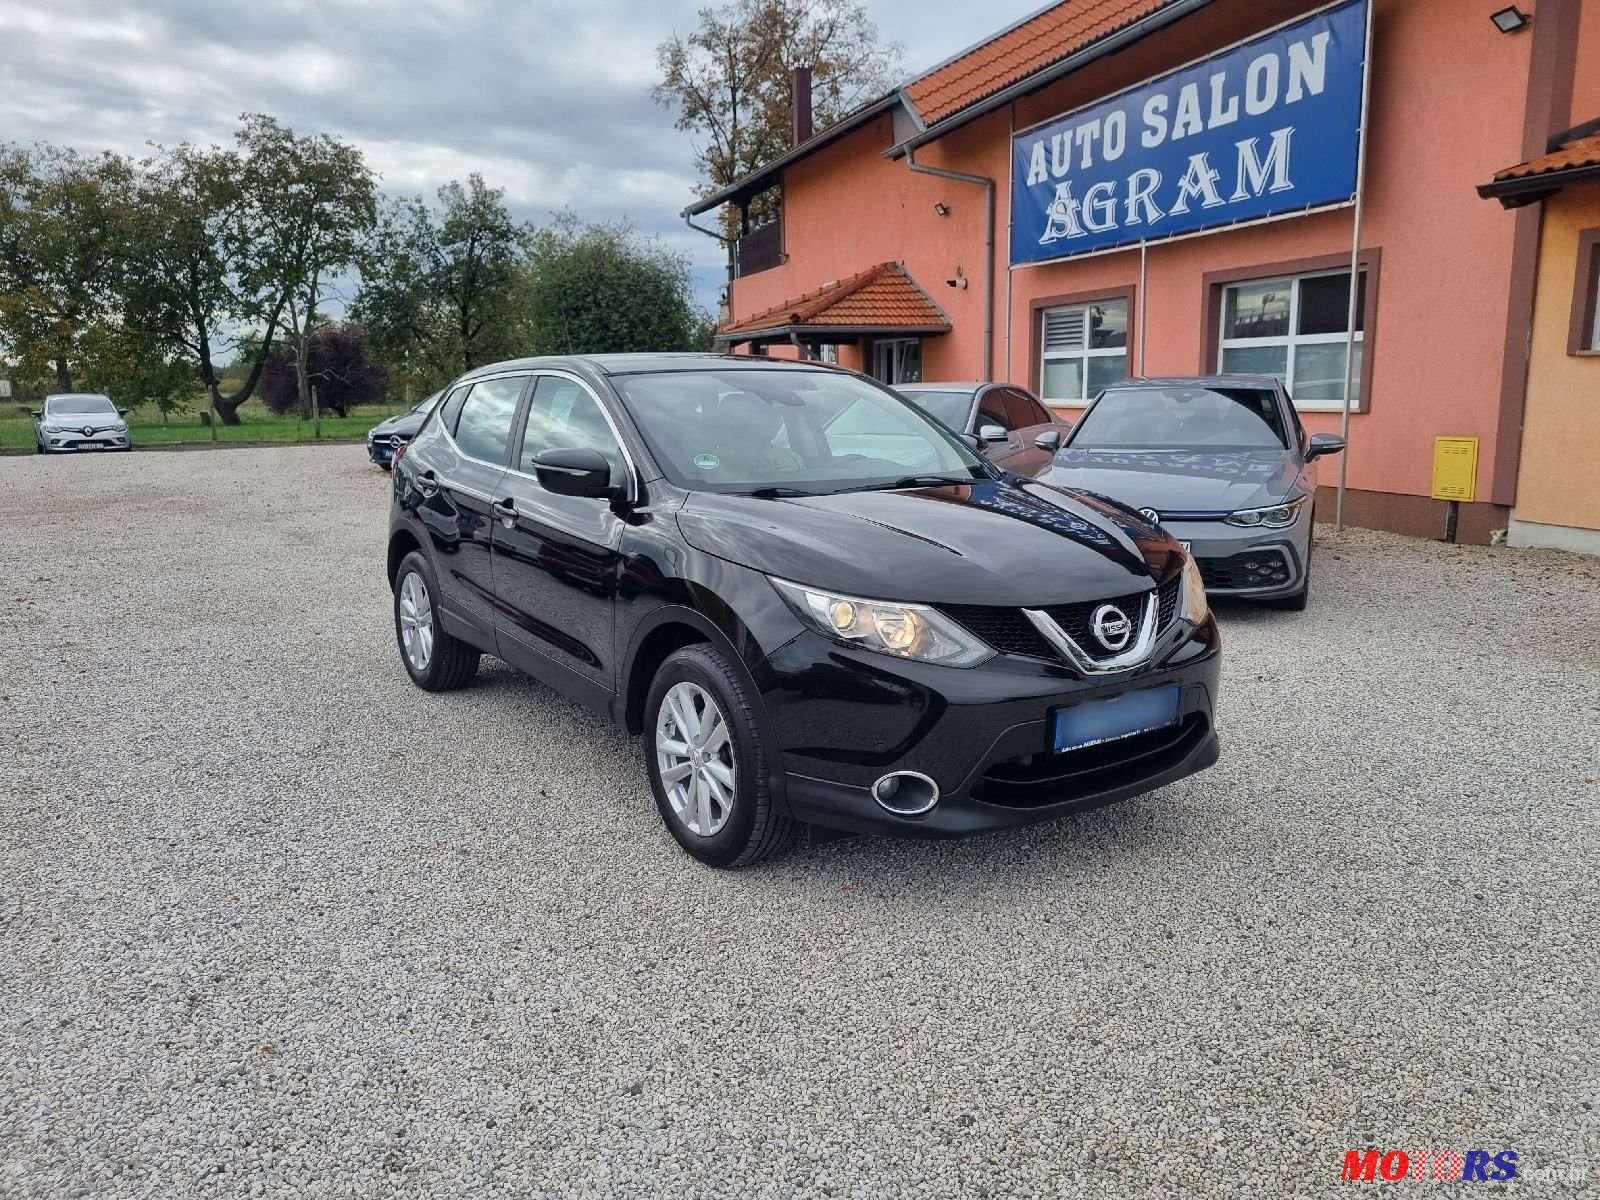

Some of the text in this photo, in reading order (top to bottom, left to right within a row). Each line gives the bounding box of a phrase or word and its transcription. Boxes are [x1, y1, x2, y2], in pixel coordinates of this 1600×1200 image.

[1026, 31, 1330, 187] AUTO SALON
[1038, 126, 1295, 245] AGRAM
